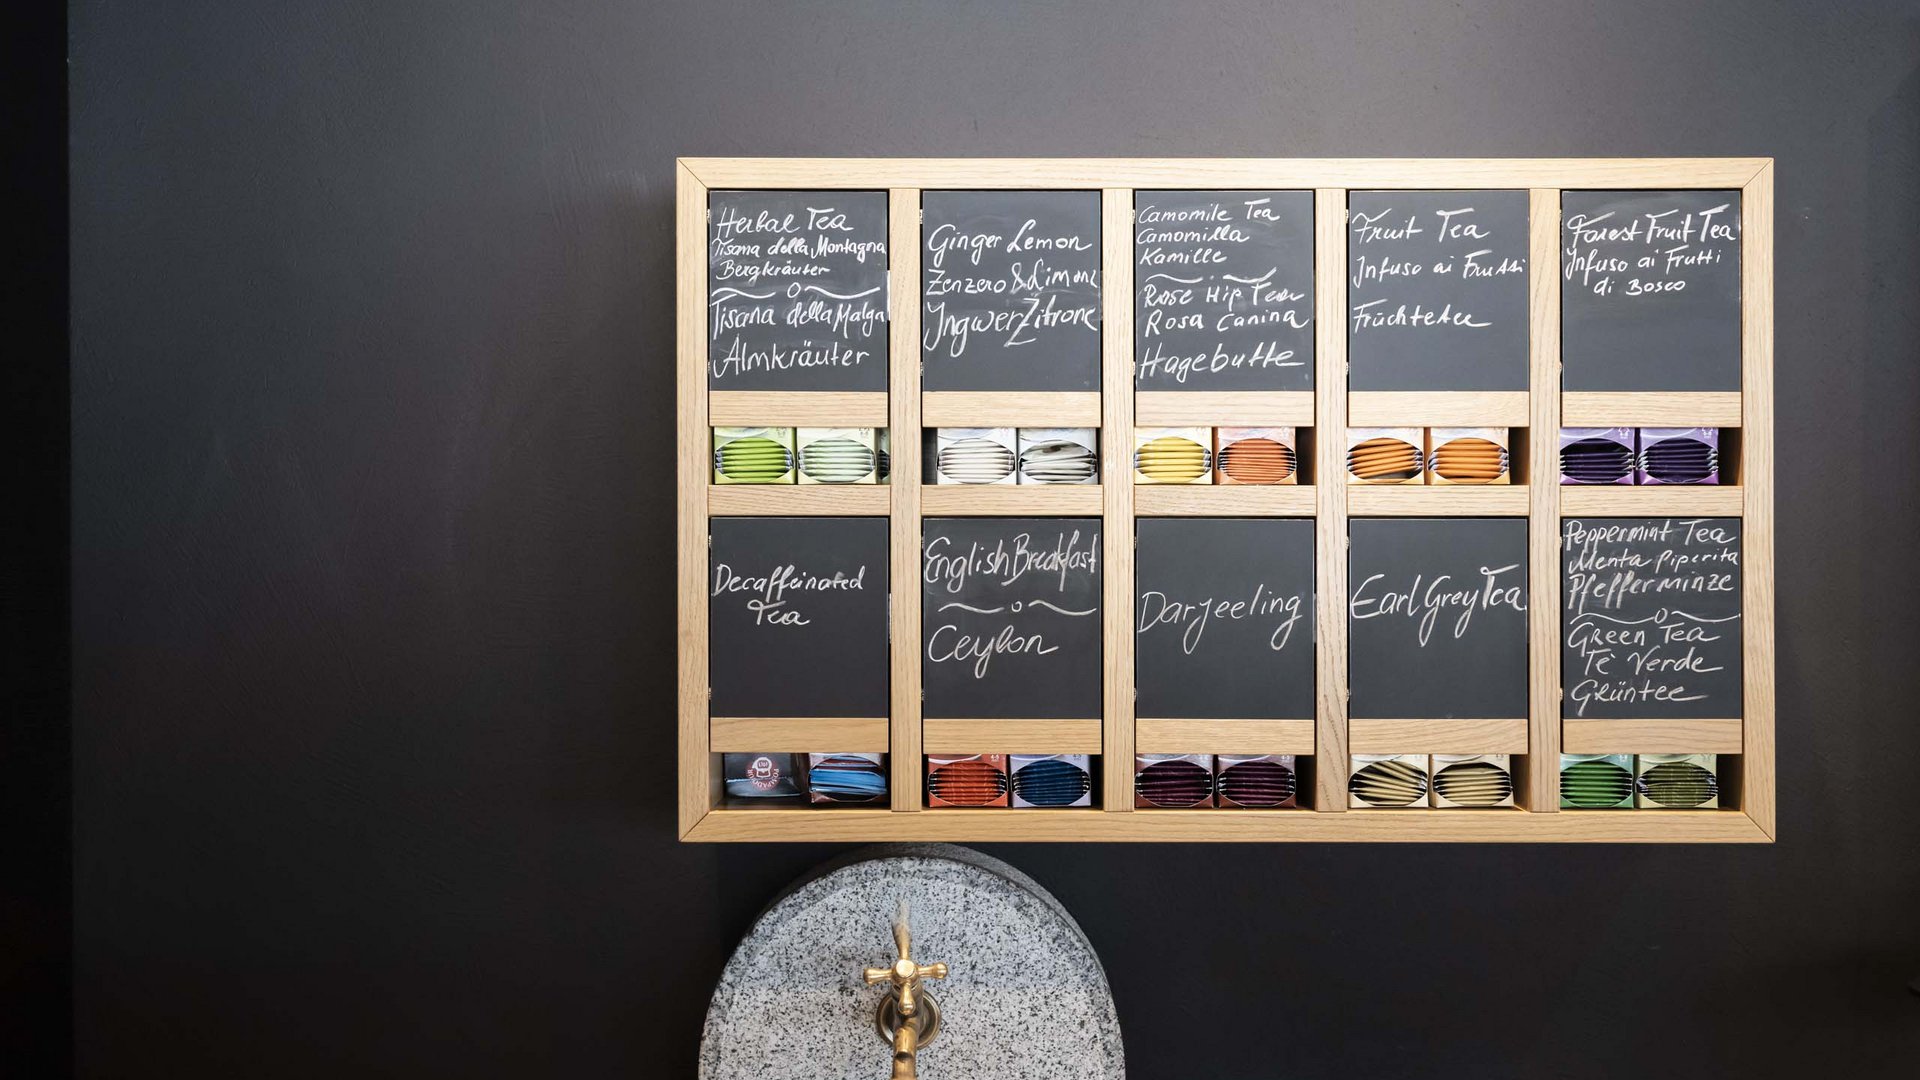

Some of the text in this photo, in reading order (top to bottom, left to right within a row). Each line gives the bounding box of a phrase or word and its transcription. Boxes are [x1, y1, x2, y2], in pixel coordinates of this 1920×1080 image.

[717, 207, 854, 238] Herbal Tea
[1139, 198, 1280, 223] Camomile Tea
[1352, 208, 1490, 244] Fruit Tea
[1567, 204, 1736, 248] Forest Fruit Tea
[768, 237, 808, 255] della
[811, 235, 886, 263] Montagna
[928, 219, 1092, 268] Ginger Lemon
[1137, 225, 1250, 244] Camomilla
[716, 260, 830, 282] Bergkräuter
[1140, 248, 1227, 265] Kamille
[1433, 256, 1454, 273] ai
[1638, 249, 1658, 267] ai
[1665, 245, 1721, 274] Frutti
[926, 269, 1006, 295] Zenzero
[1139, 282, 1304, 311] Rose Hip Tea
[1594, 277, 1685, 296] di Bosco
[710, 294, 885, 340] Tisana della Malga
[1145, 309, 1310, 337] Rosa Canina
[713, 333, 869, 378] Almkräuter
[1140, 342, 1305, 382] Hagebutte
[1565, 519, 1736, 552] Peppermint Tea
[926, 529, 1098, 592] English Breakfast
[1569, 549, 1652, 574] Menta
[712, 564, 865, 603] Decaffeinated
[1568, 571, 1734, 614] Pfefferminze
[747, 600, 810, 625] Tea
[1137, 584, 1302, 654] Darjeeling
[1351, 564, 1527, 647] Earl Grey Tea
[928, 625, 1059, 678] Ceylon
[1568, 622, 1721, 657] Green Tea
[1586, 645, 1723, 675] Tè Verde
[1571, 680, 1709, 718] Grüntee
